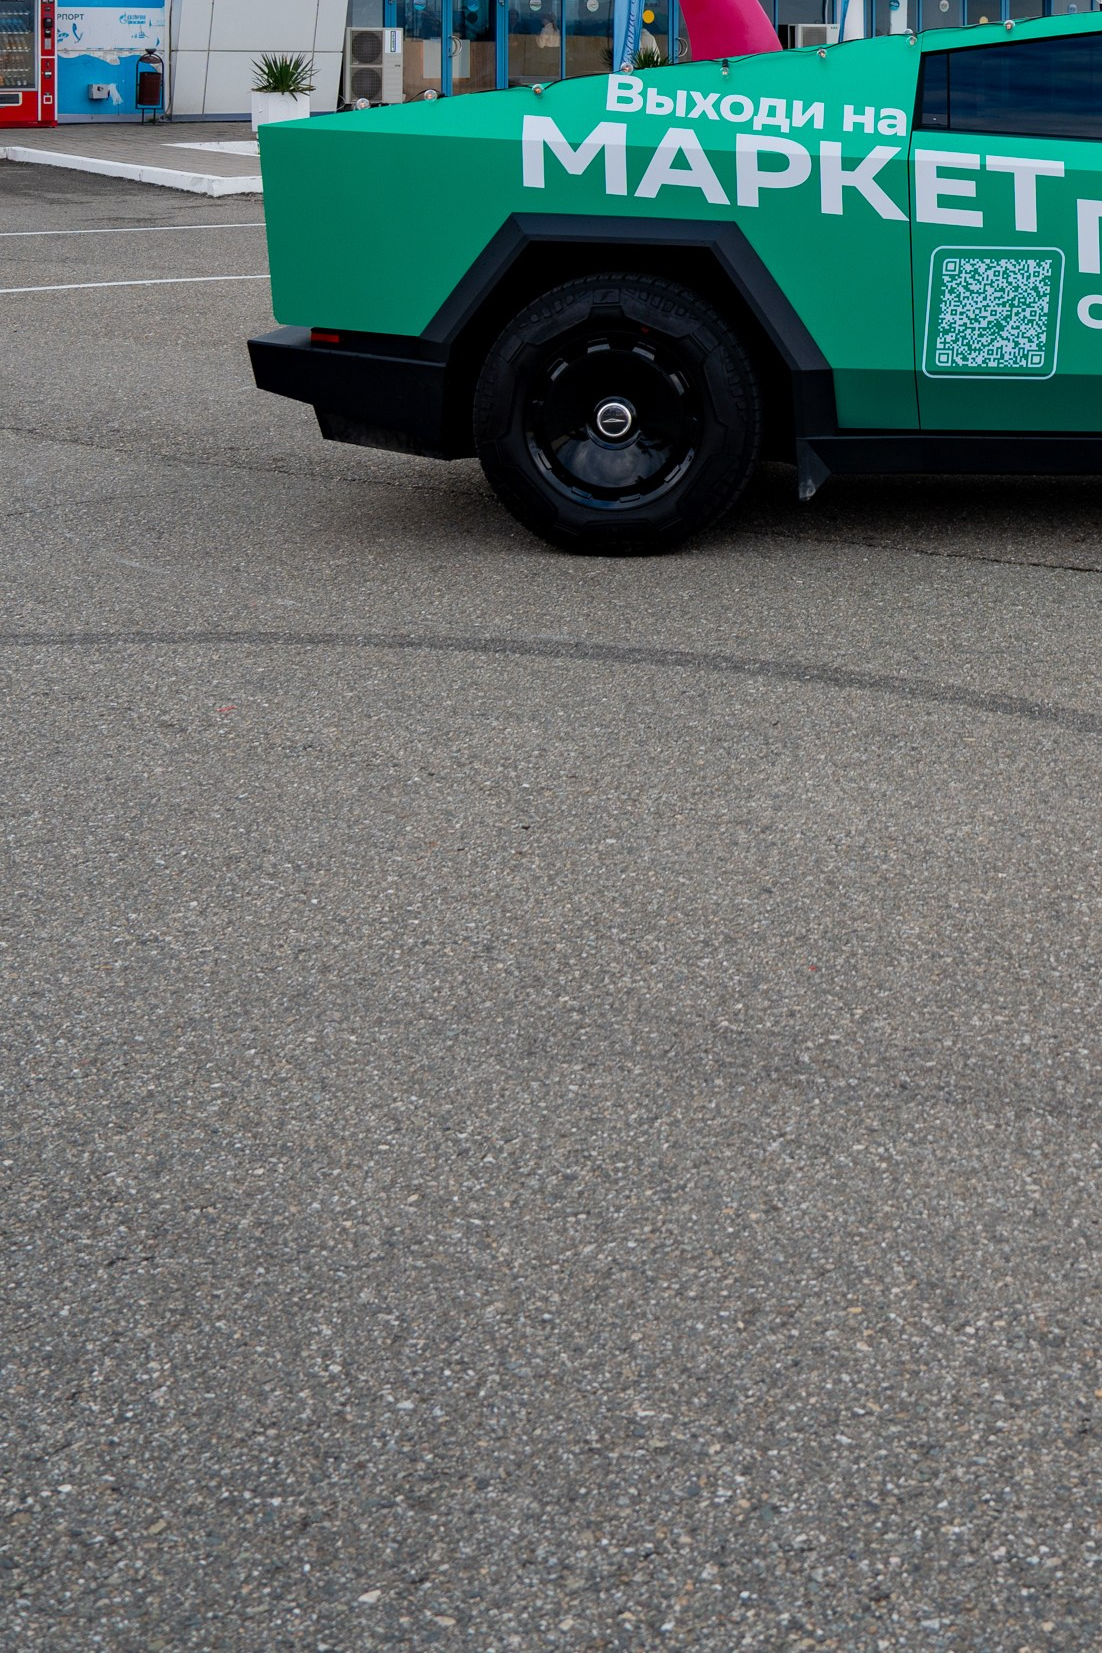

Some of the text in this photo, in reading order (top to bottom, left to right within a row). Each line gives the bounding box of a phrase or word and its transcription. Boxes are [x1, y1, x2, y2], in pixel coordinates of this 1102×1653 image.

[605, 73, 908, 137] Выходи на
[521, 114, 1066, 233] МАРКЕТ
